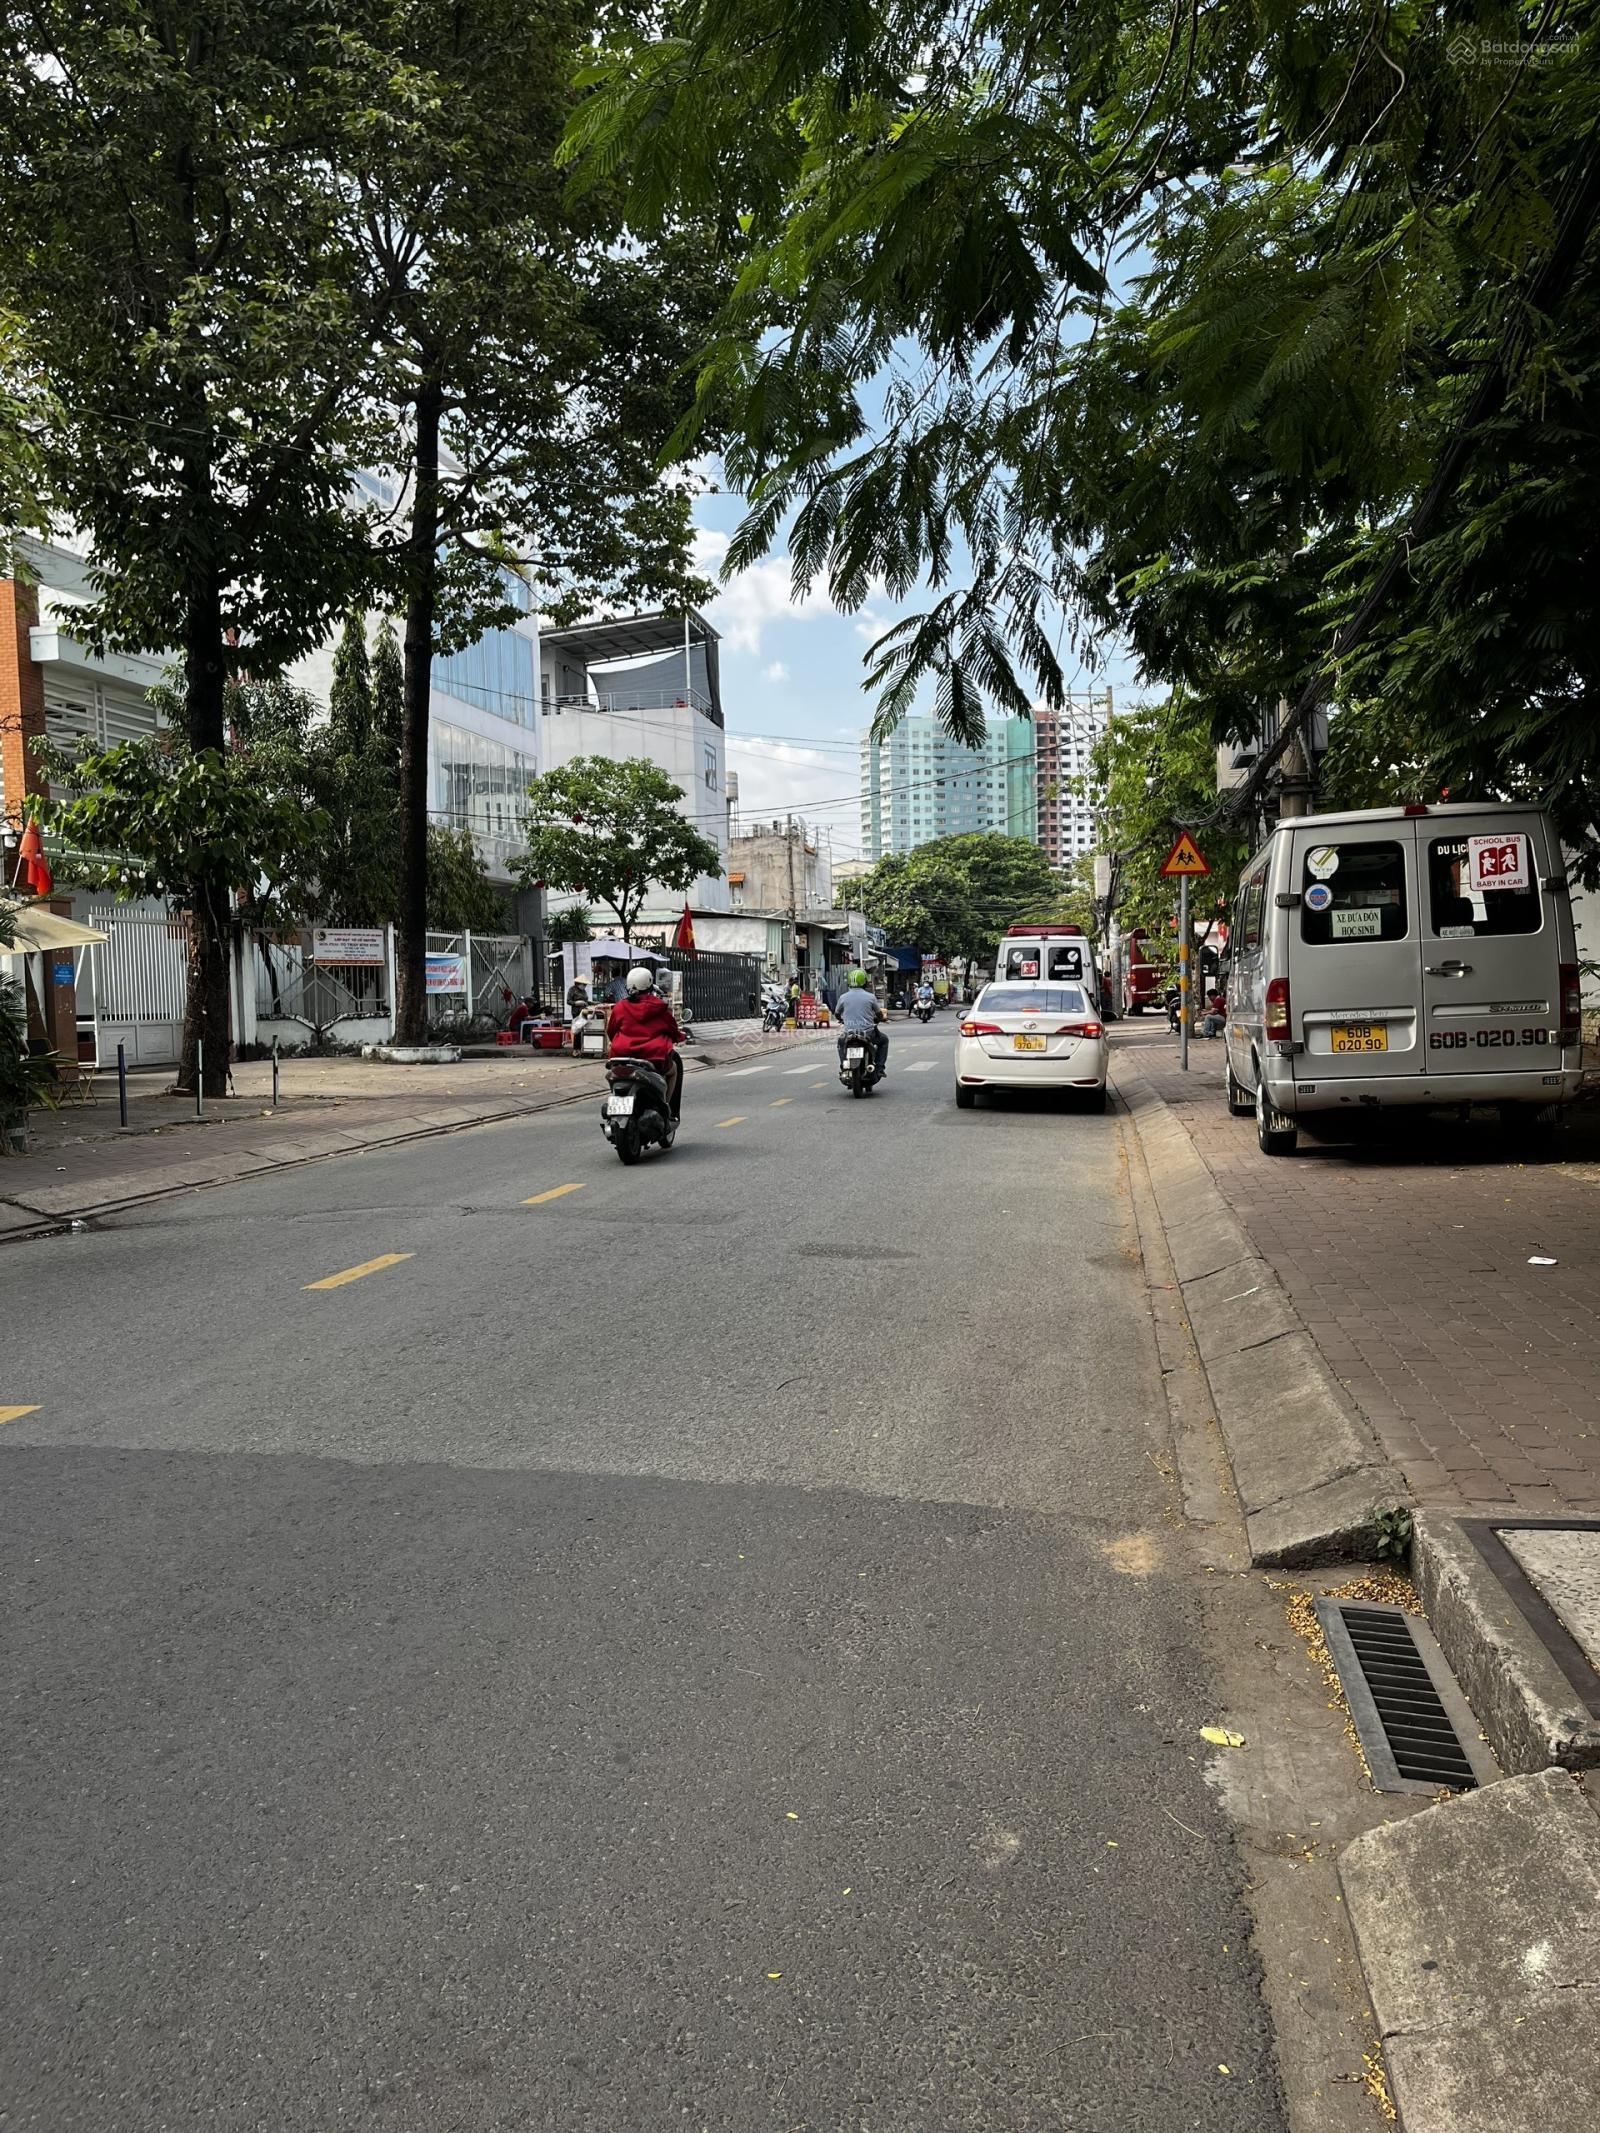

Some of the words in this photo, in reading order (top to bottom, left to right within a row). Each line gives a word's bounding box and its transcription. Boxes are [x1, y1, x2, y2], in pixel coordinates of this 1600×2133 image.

[1473, 837, 1504, 846] SCHOOL
[1506, 835, 1521, 843] BUS
[1437, 845, 1450, 856] DU
[1476, 880, 1497, 888] BABY
[1507, 878, 1524, 886] CAR
[1337, 913, 1347, 924] XE
[1341, 926, 1357, 937] HỌC
[1358, 925, 1375, 935] SINH
[1347, 1027, 1372, 1039] 60B
[1429, 1028, 1548, 1050] 60B-020.90
[1338, 1039, 1382, 1051] 020.90
